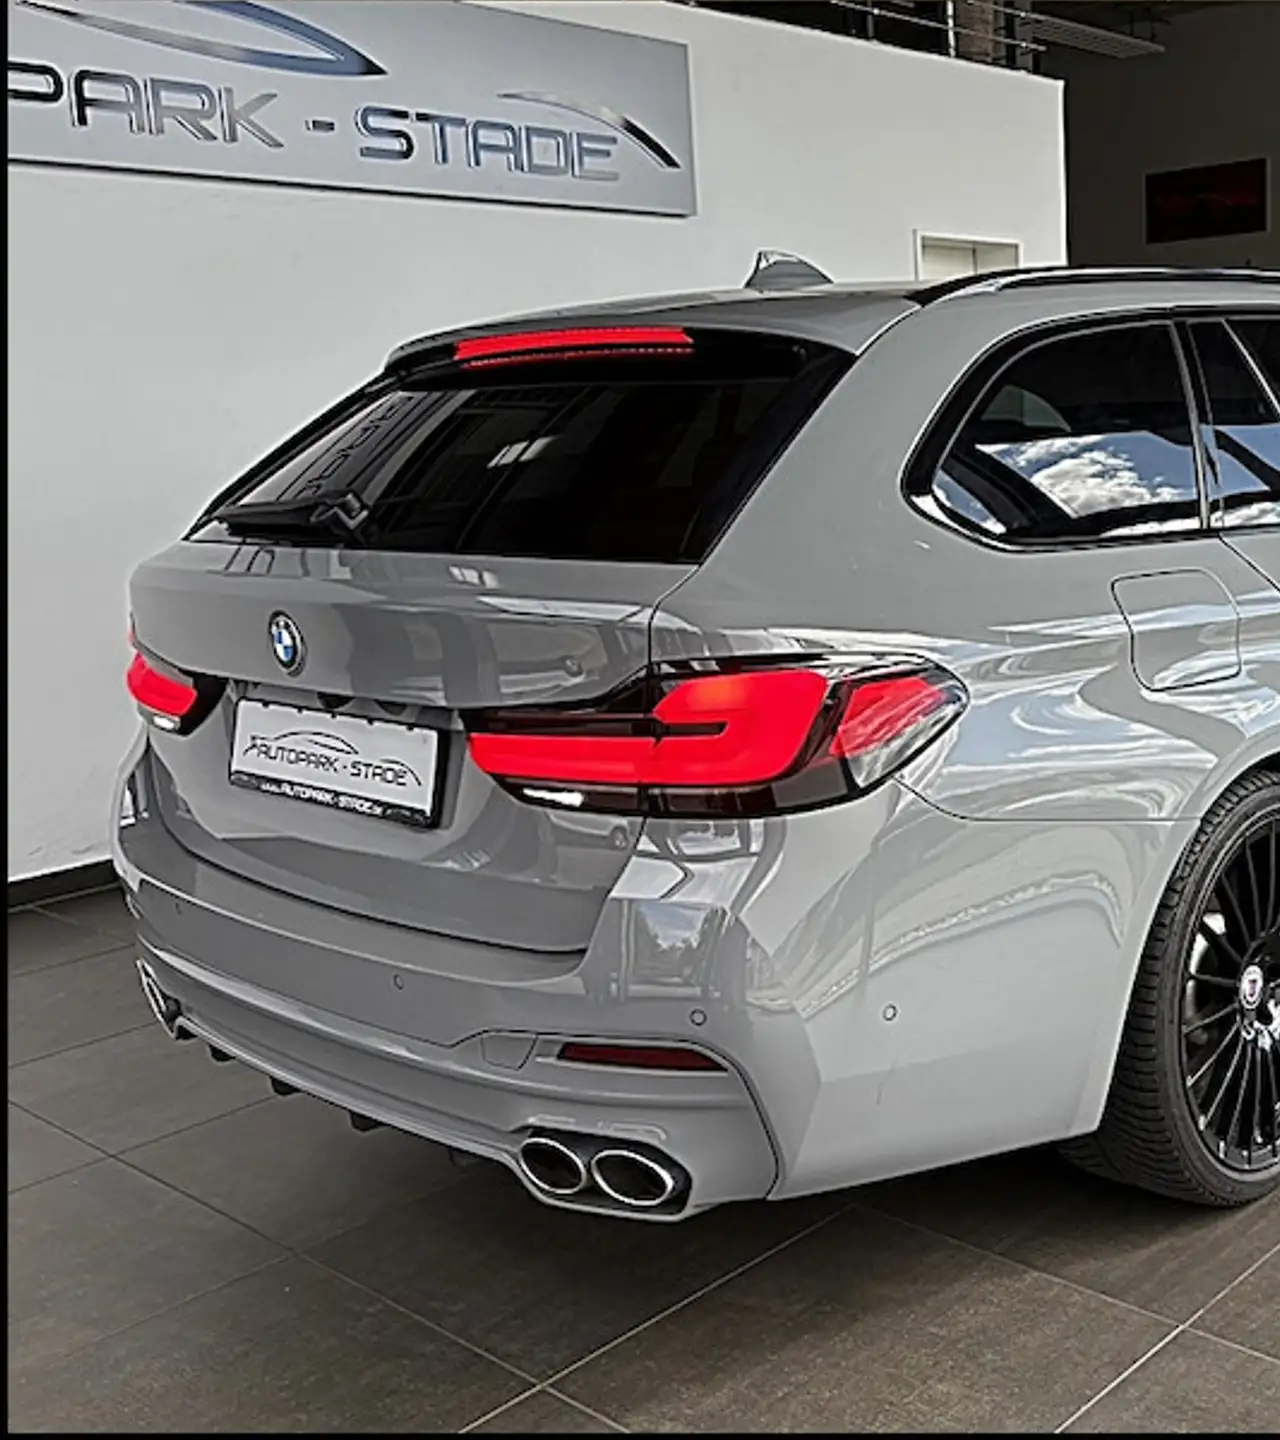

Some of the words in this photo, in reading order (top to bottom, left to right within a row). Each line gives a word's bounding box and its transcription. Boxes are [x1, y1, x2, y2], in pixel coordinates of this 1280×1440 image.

[356, 105, 620, 182] STADE
[257, 743, 338, 772] AUTOPARK
[350, 760, 408, 787] STADE
